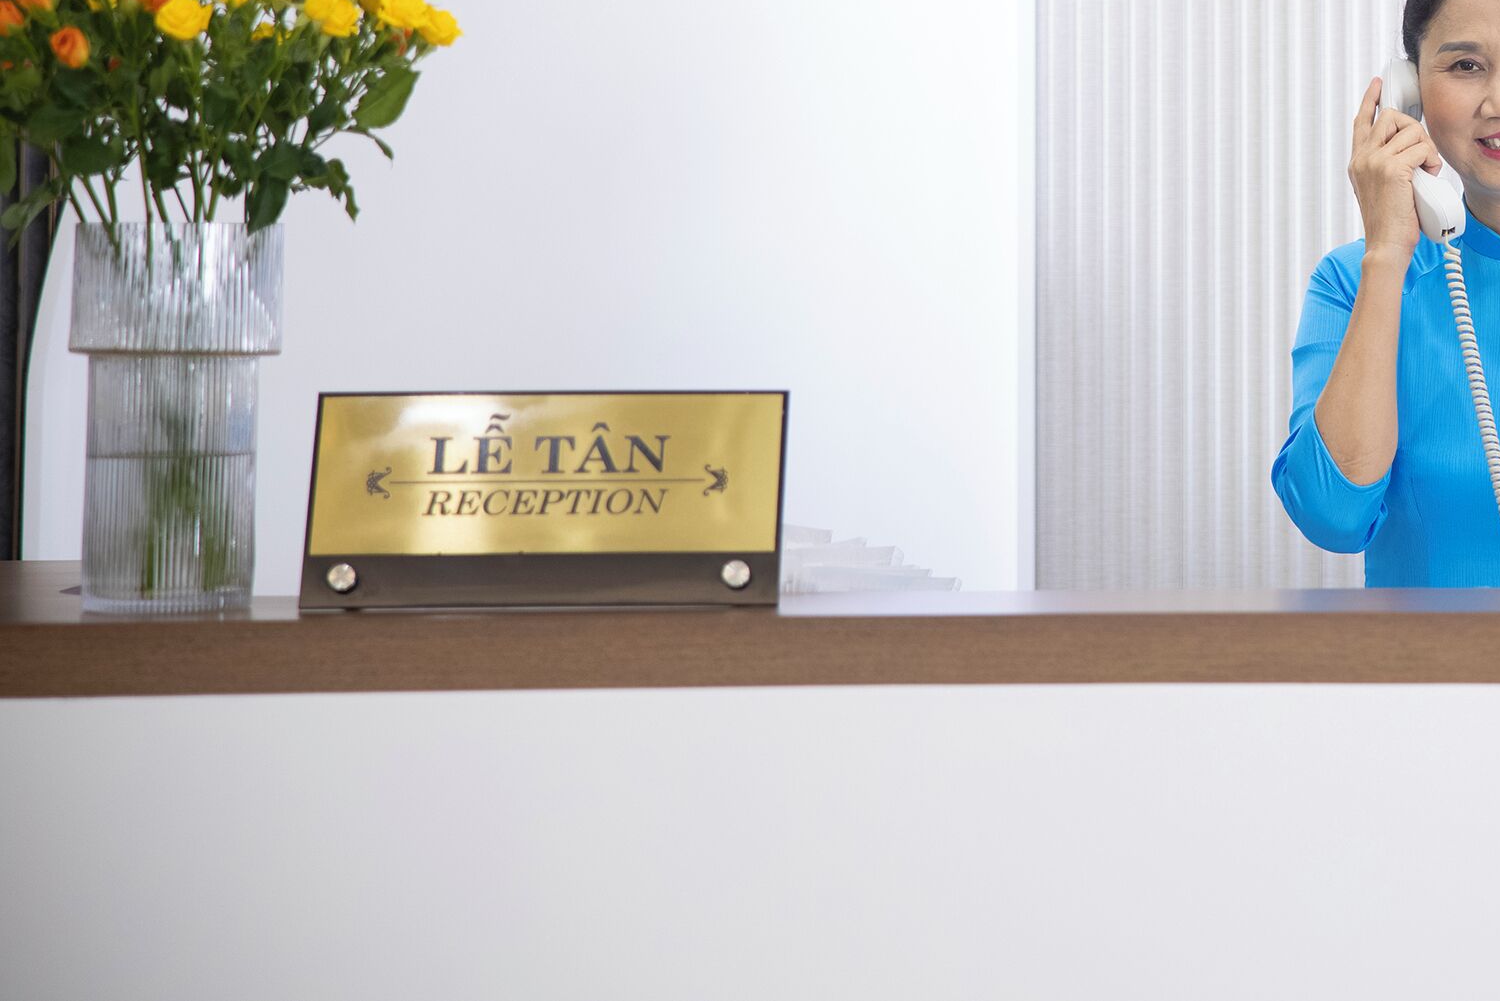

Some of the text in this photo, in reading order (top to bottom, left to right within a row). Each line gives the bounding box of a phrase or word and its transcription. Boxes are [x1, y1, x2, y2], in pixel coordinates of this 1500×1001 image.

[426, 412, 672, 475] LỄ TÂN
[421, 487, 668, 517] RECEPTION
